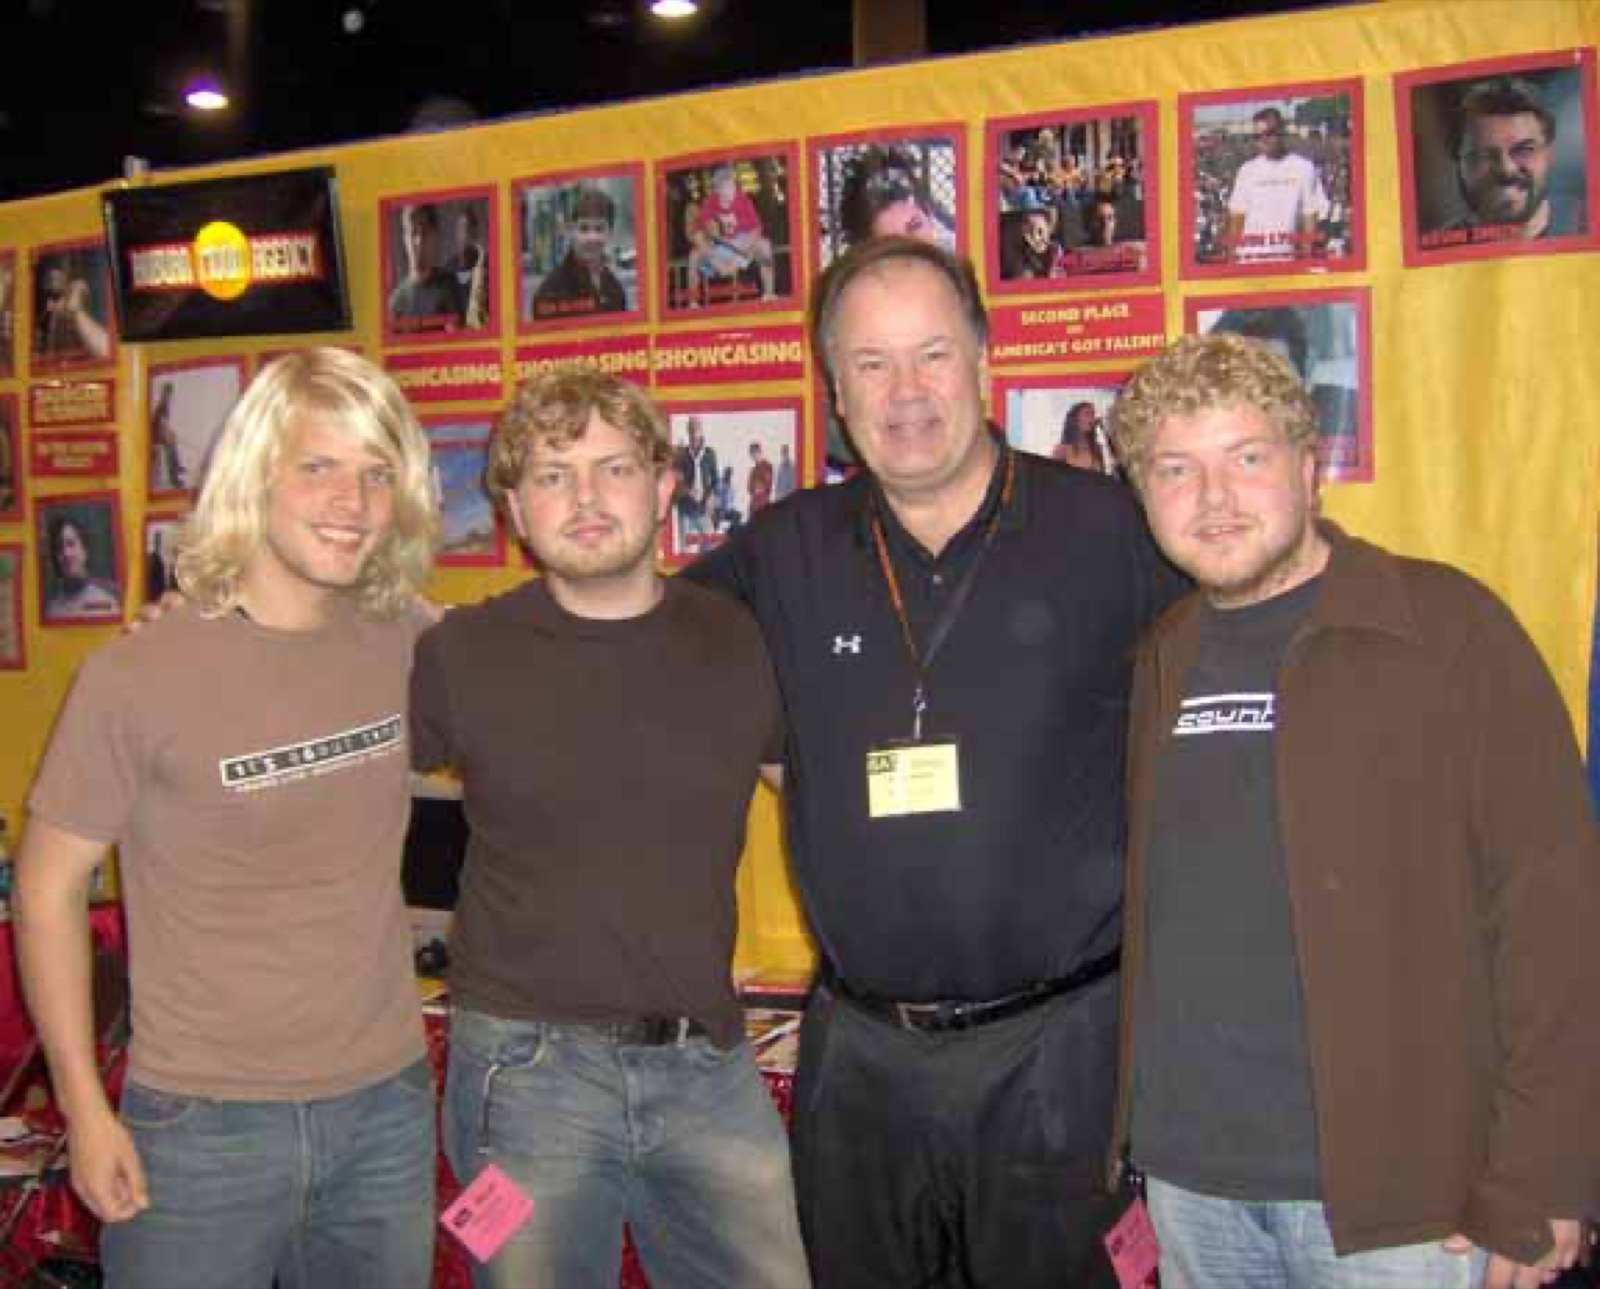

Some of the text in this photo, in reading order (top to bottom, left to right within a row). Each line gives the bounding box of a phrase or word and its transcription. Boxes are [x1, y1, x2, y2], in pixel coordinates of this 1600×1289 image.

[1022, 303, 1129, 325] SECOND PLACE
[655, 341, 801, 370] SHOWCASING
[993, 341, 1068, 358] AMERICA'S
[1072, 337, 1102, 354] GOT
